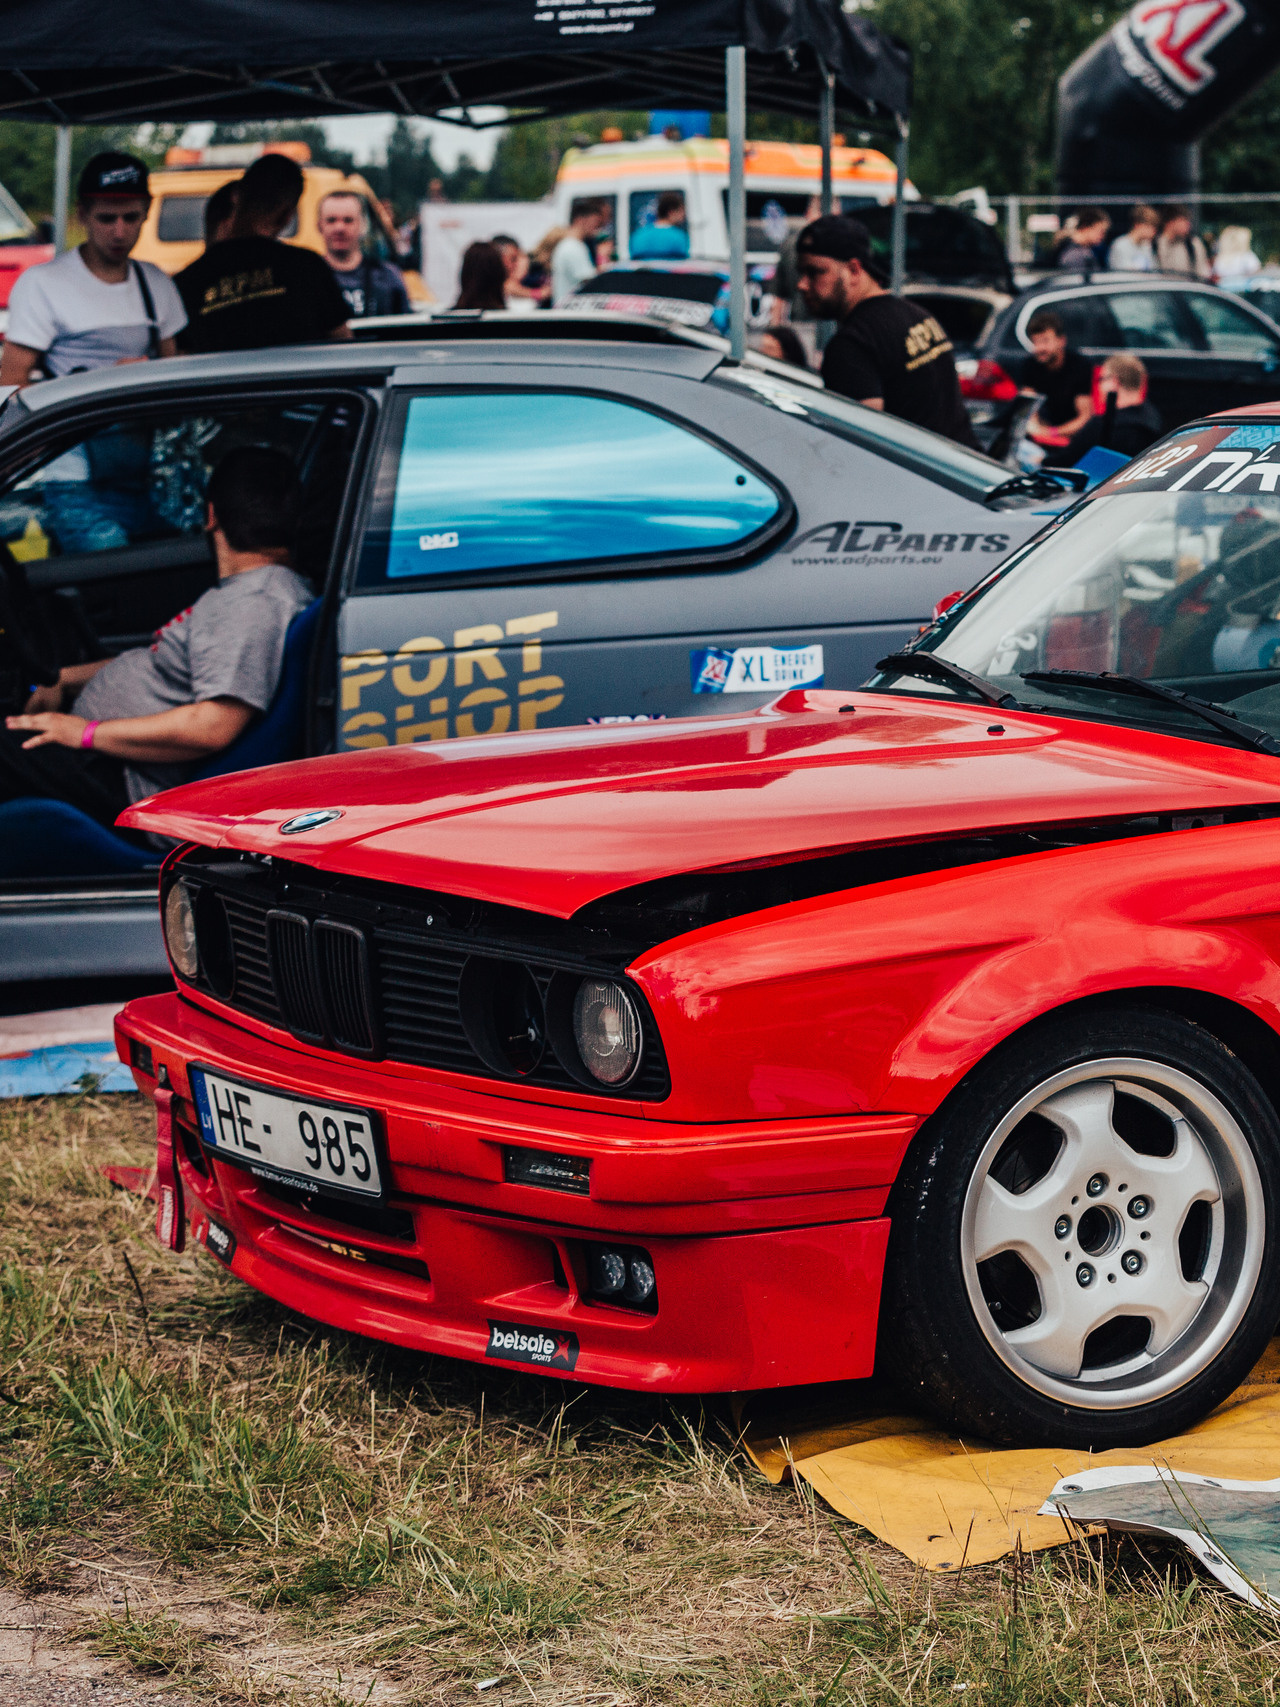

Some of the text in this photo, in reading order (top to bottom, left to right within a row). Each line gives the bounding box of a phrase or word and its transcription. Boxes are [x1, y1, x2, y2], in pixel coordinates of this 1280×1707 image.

[792, 554, 943, 567] www.adparts.eu
[742, 655, 771, 682] XL
[774, 653, 815, 666] ENERGY
[298, 1110, 372, 1182] 985
[491, 1327, 555, 1355] betsafe
[531, 1353, 552, 1363] SPORTS
